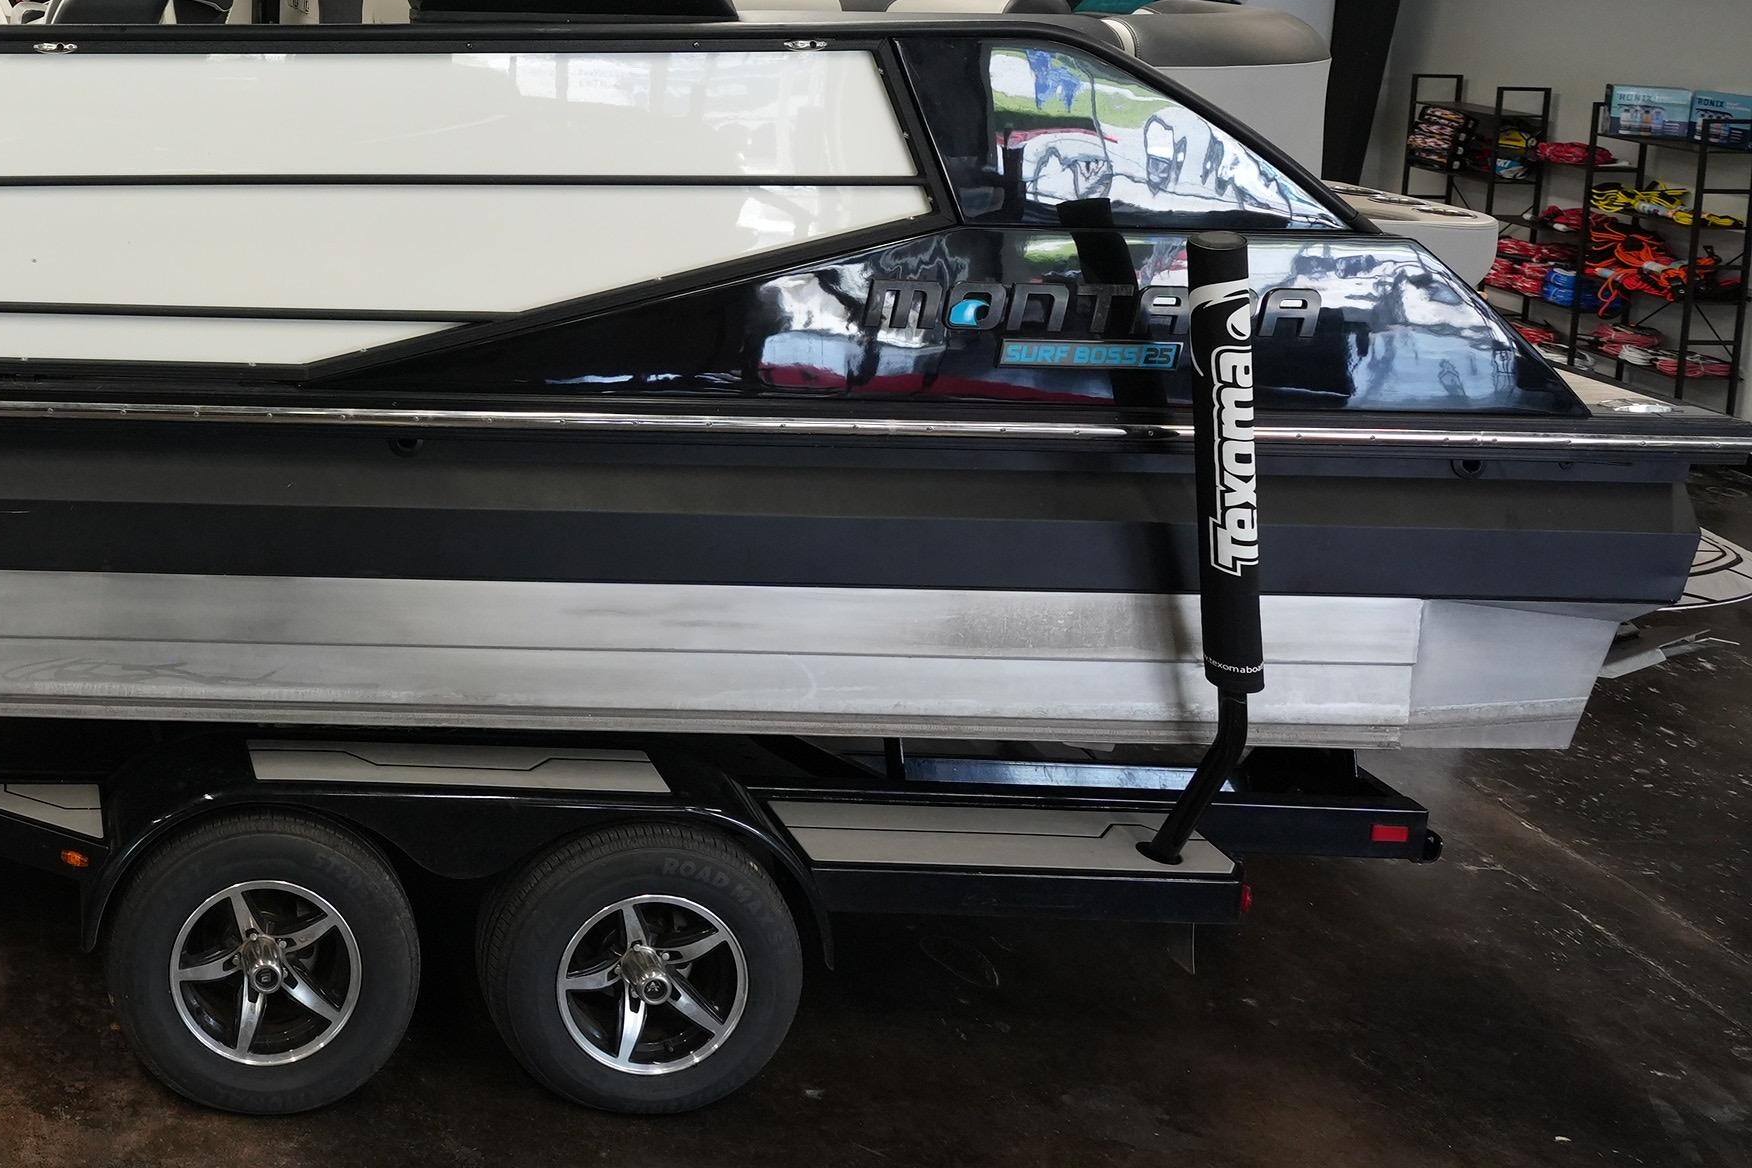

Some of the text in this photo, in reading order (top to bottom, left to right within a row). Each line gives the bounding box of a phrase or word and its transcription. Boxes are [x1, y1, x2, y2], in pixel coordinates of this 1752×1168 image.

[862, 278, 1325, 339] MONTAA
[1005, 343, 1174, 365] SURF BOSS 25
[1211, 346, 1259, 574] Texoma
